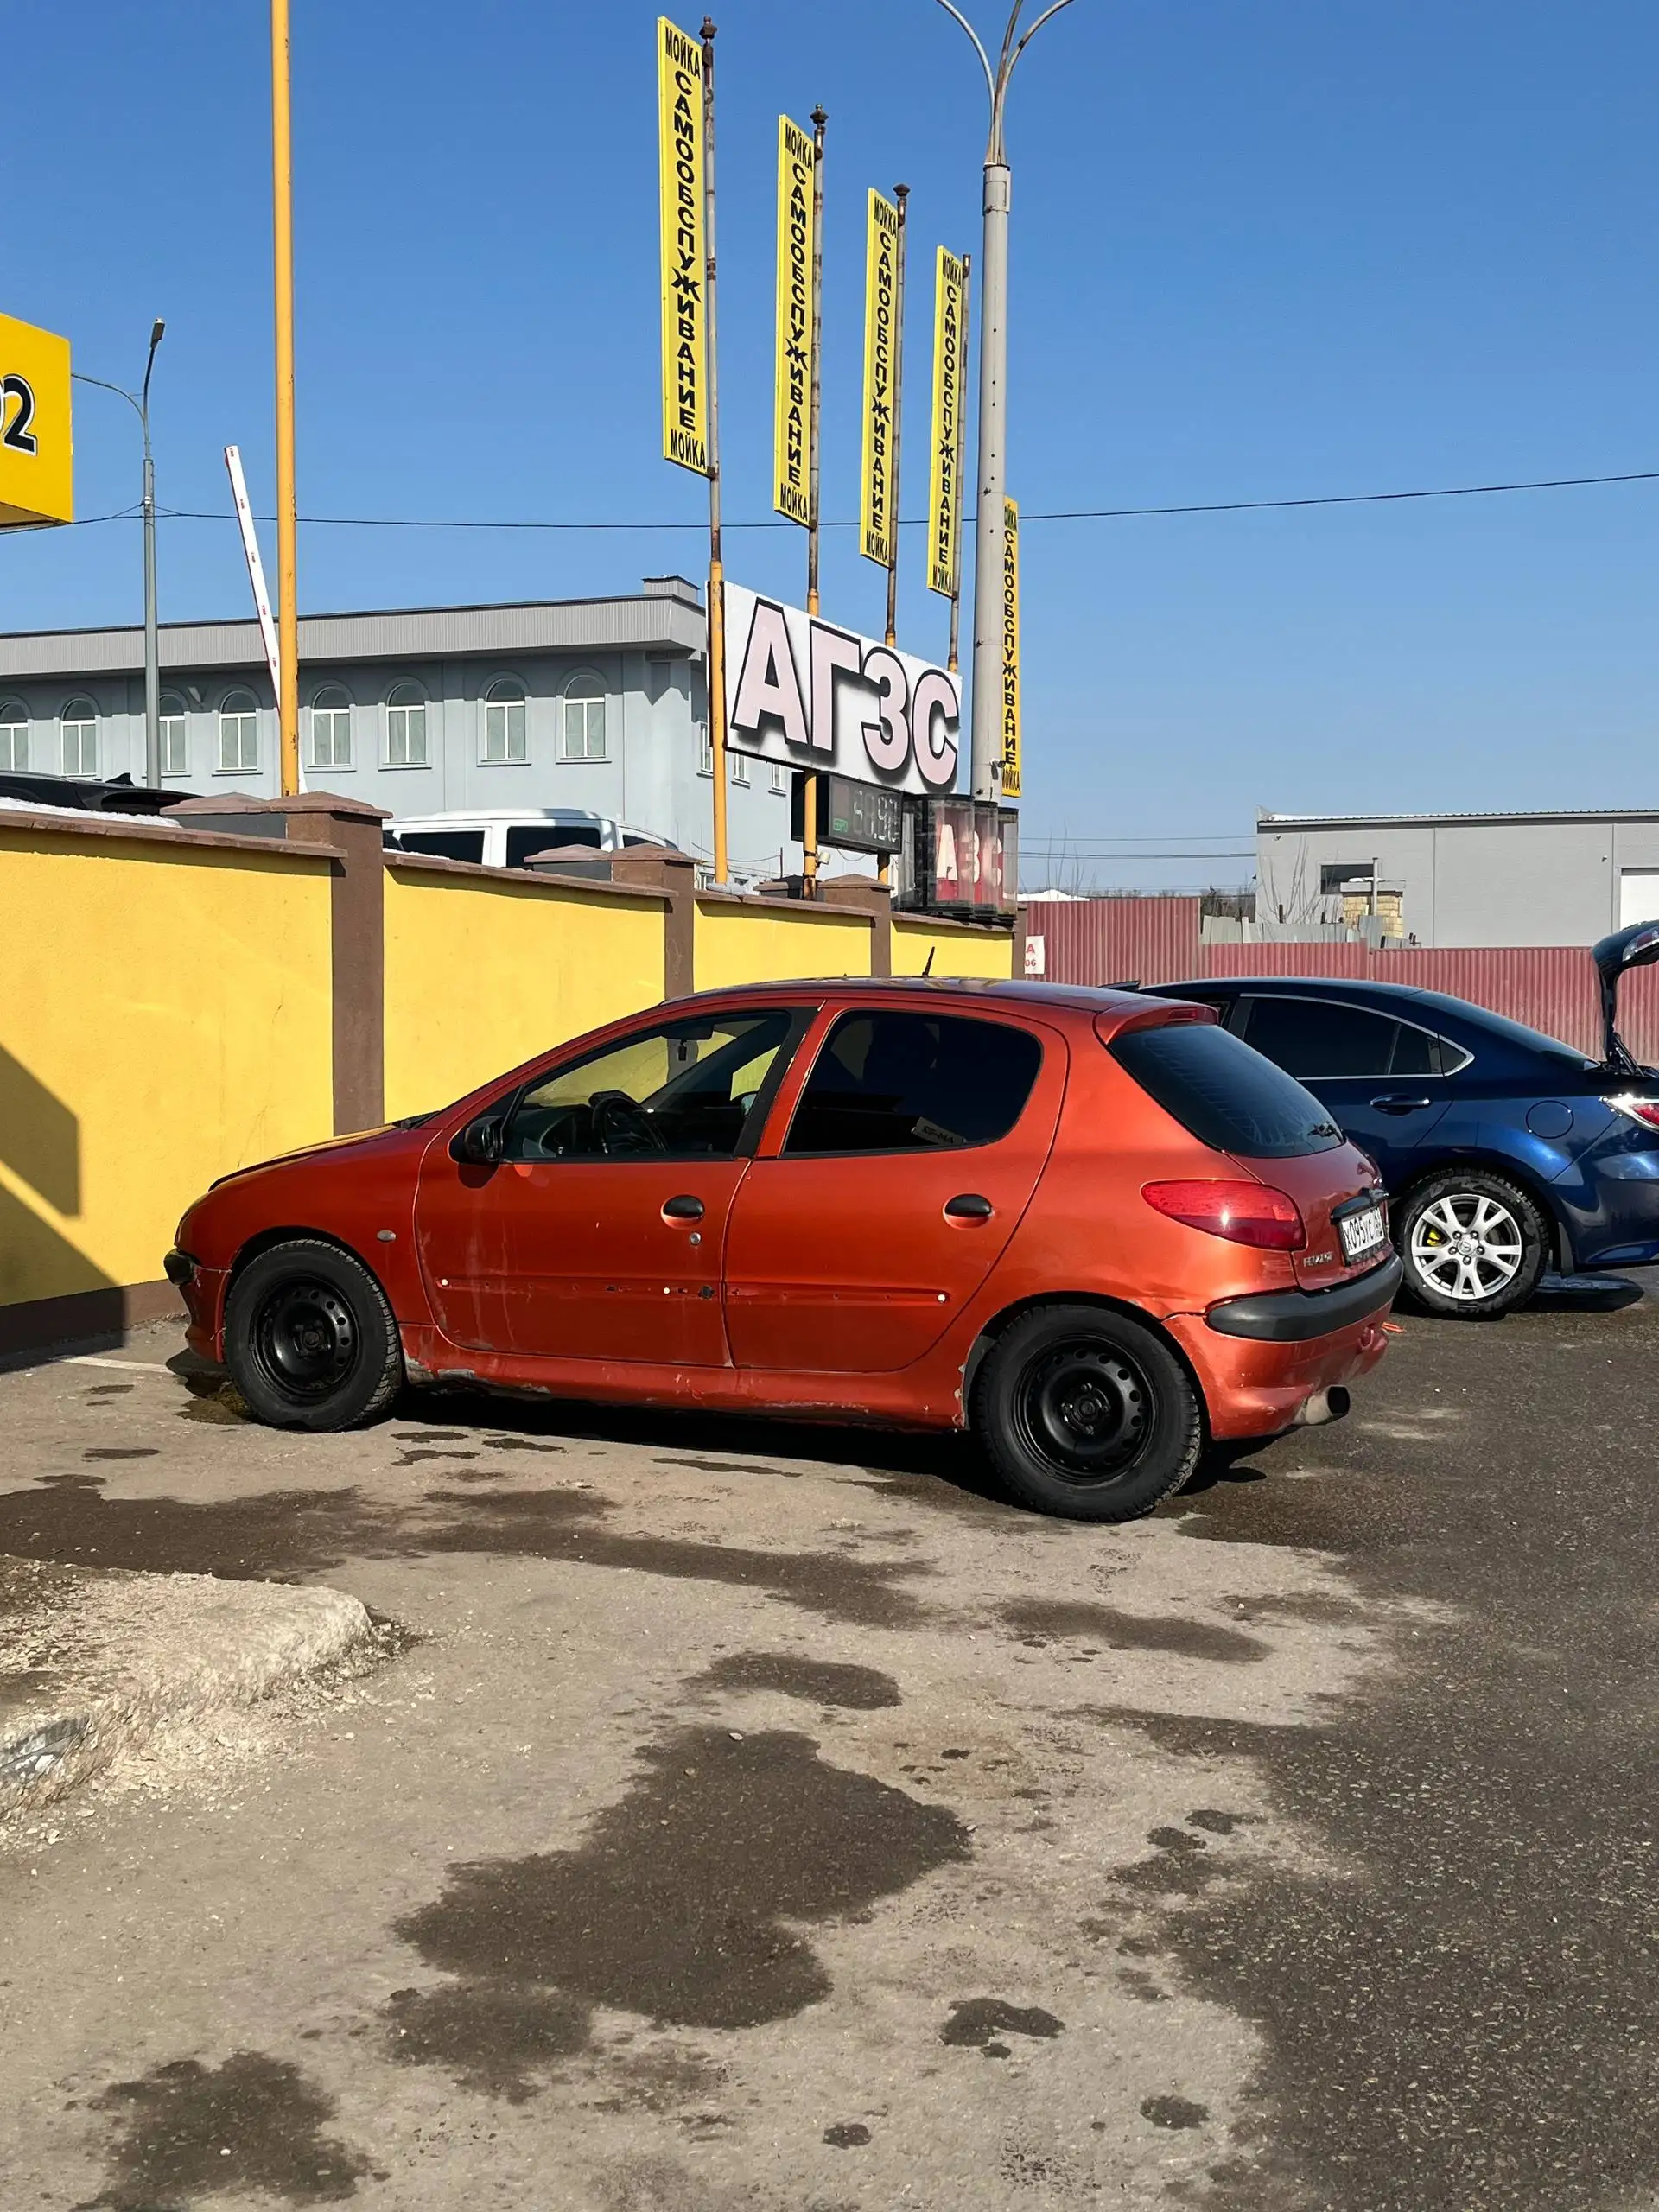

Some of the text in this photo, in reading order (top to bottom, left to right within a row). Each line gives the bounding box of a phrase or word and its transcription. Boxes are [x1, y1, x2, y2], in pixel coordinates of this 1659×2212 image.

[665, 26, 701, 80] МОЙКА
[785, 124, 813, 172] МОЙКА
[874, 197, 897, 239] МОЙКА
[0, 373, 37, 457] 2
[671, 429, 706, 470] МОЙКА
[780, 483, 808, 522] МОЙКА
[866, 530, 888, 563] МОЙКА
[730, 596, 958, 785] АГЗС
[936, 823, 1002, 887] АЗС
